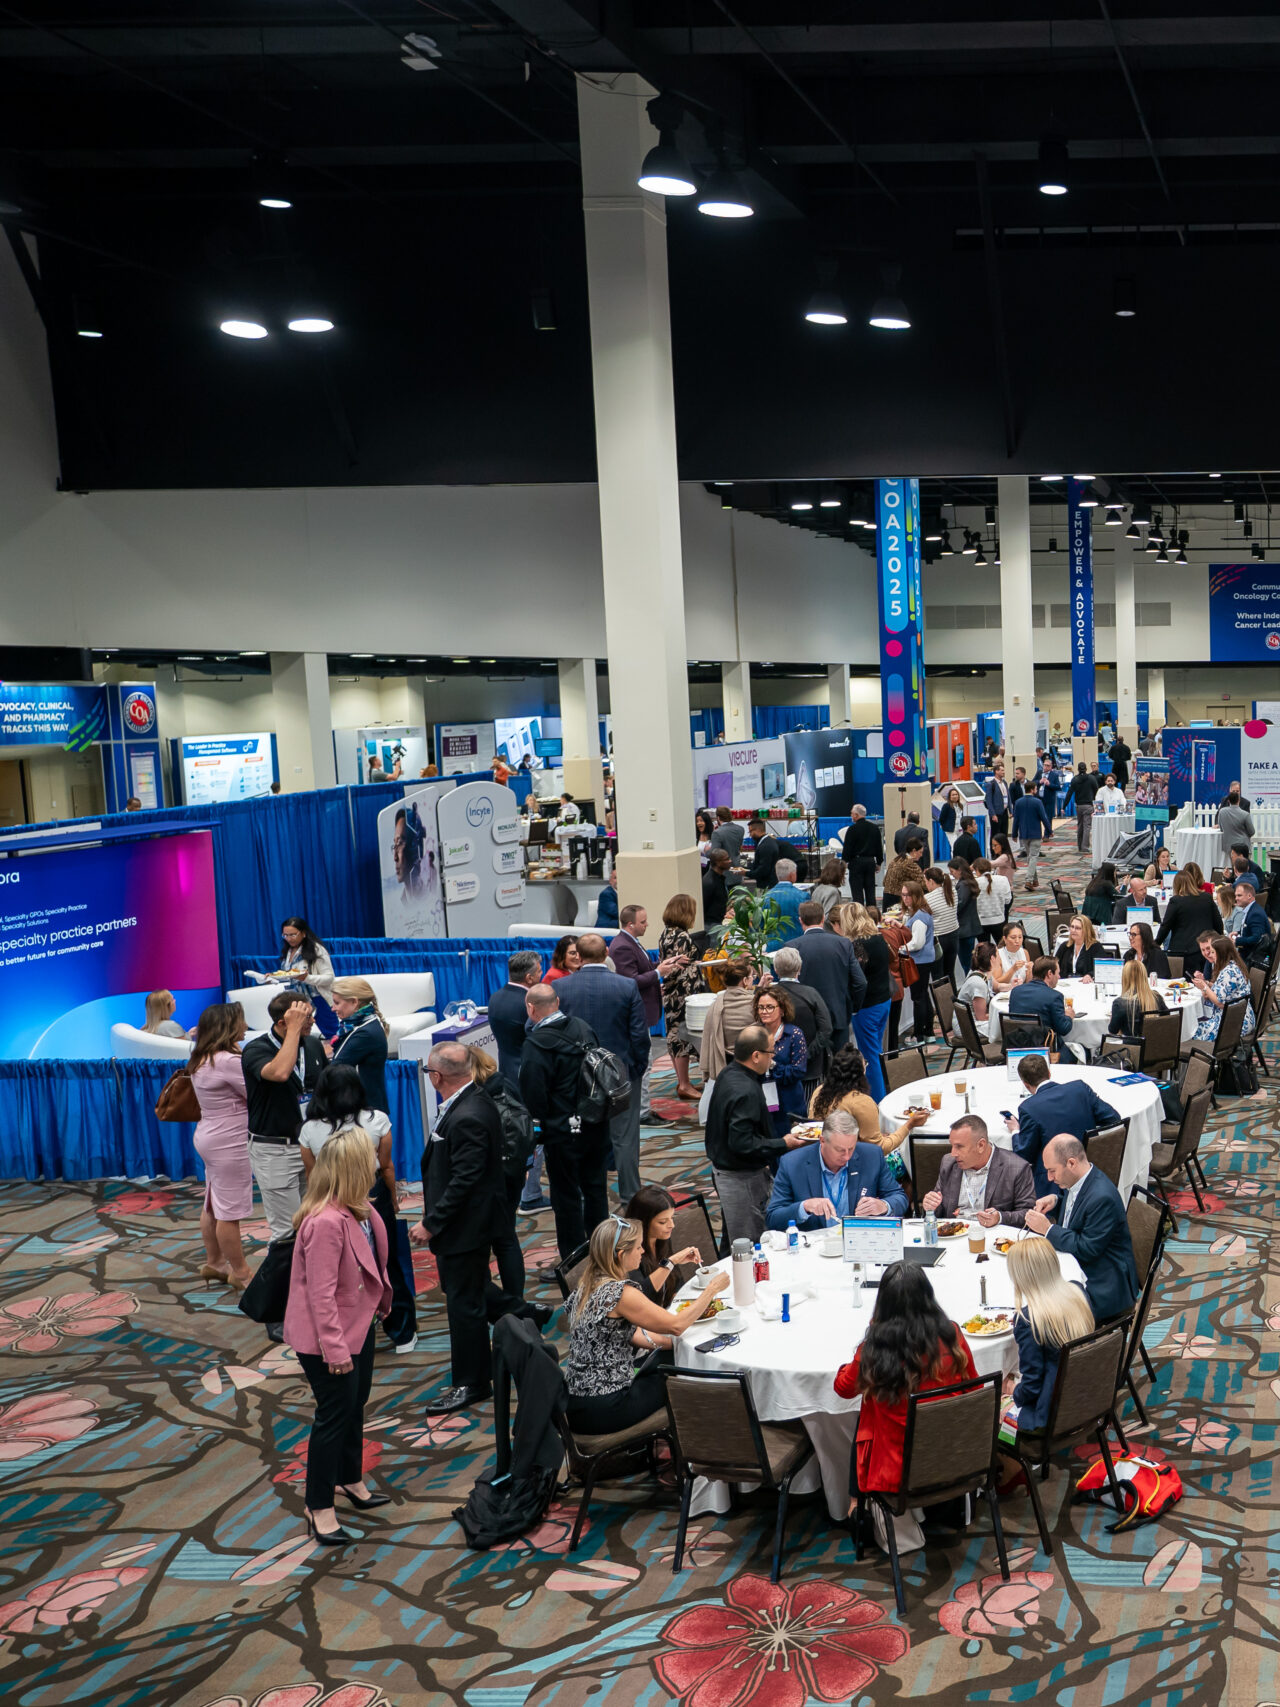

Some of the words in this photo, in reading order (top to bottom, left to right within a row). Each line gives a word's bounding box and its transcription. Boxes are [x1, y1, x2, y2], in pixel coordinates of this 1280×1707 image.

[1073, 511, 1084, 575] EMPOWER
[1075, 579, 1084, 588] &
[1233, 593, 1270, 601] Oncology
[1236, 612, 1262, 620] Where
[1075, 592, 1085, 664] ADVOCATE
[1234, 621, 1261, 629] Cancer
[38, 701, 74, 711] CLINICAL,
[3, 713, 22, 723] AND
[22, 712, 65, 722] PHARMACY
[130, 702, 149, 723] COA
[1, 724, 33, 734] TRACKS
[33, 723, 52, 733] THIS
[52, 723, 69, 732] WAY
[893, 757, 907, 770] COA
[1247, 762, 1270, 770] TAKE
[1271, 762, 1279, 770] A
[469, 807, 491, 818] Incyte
[5, 914, 29, 923] Specialty
[29, 910, 45, 919] GPOs
[45, 907, 68, 916] Specialty
[68, 904, 88, 912] Practice
[2, 922, 26, 931] Specialty
[26, 918, 49, 927] Solutions
[50, 925, 94, 944] practice
[95, 916, 138, 936] partners
[5, 956, 26, 966] better
[27, 952, 46, 961] future
[47, 949, 57, 957] for
[57, 943, 90, 955] community
[90, 940, 104, 949] care
